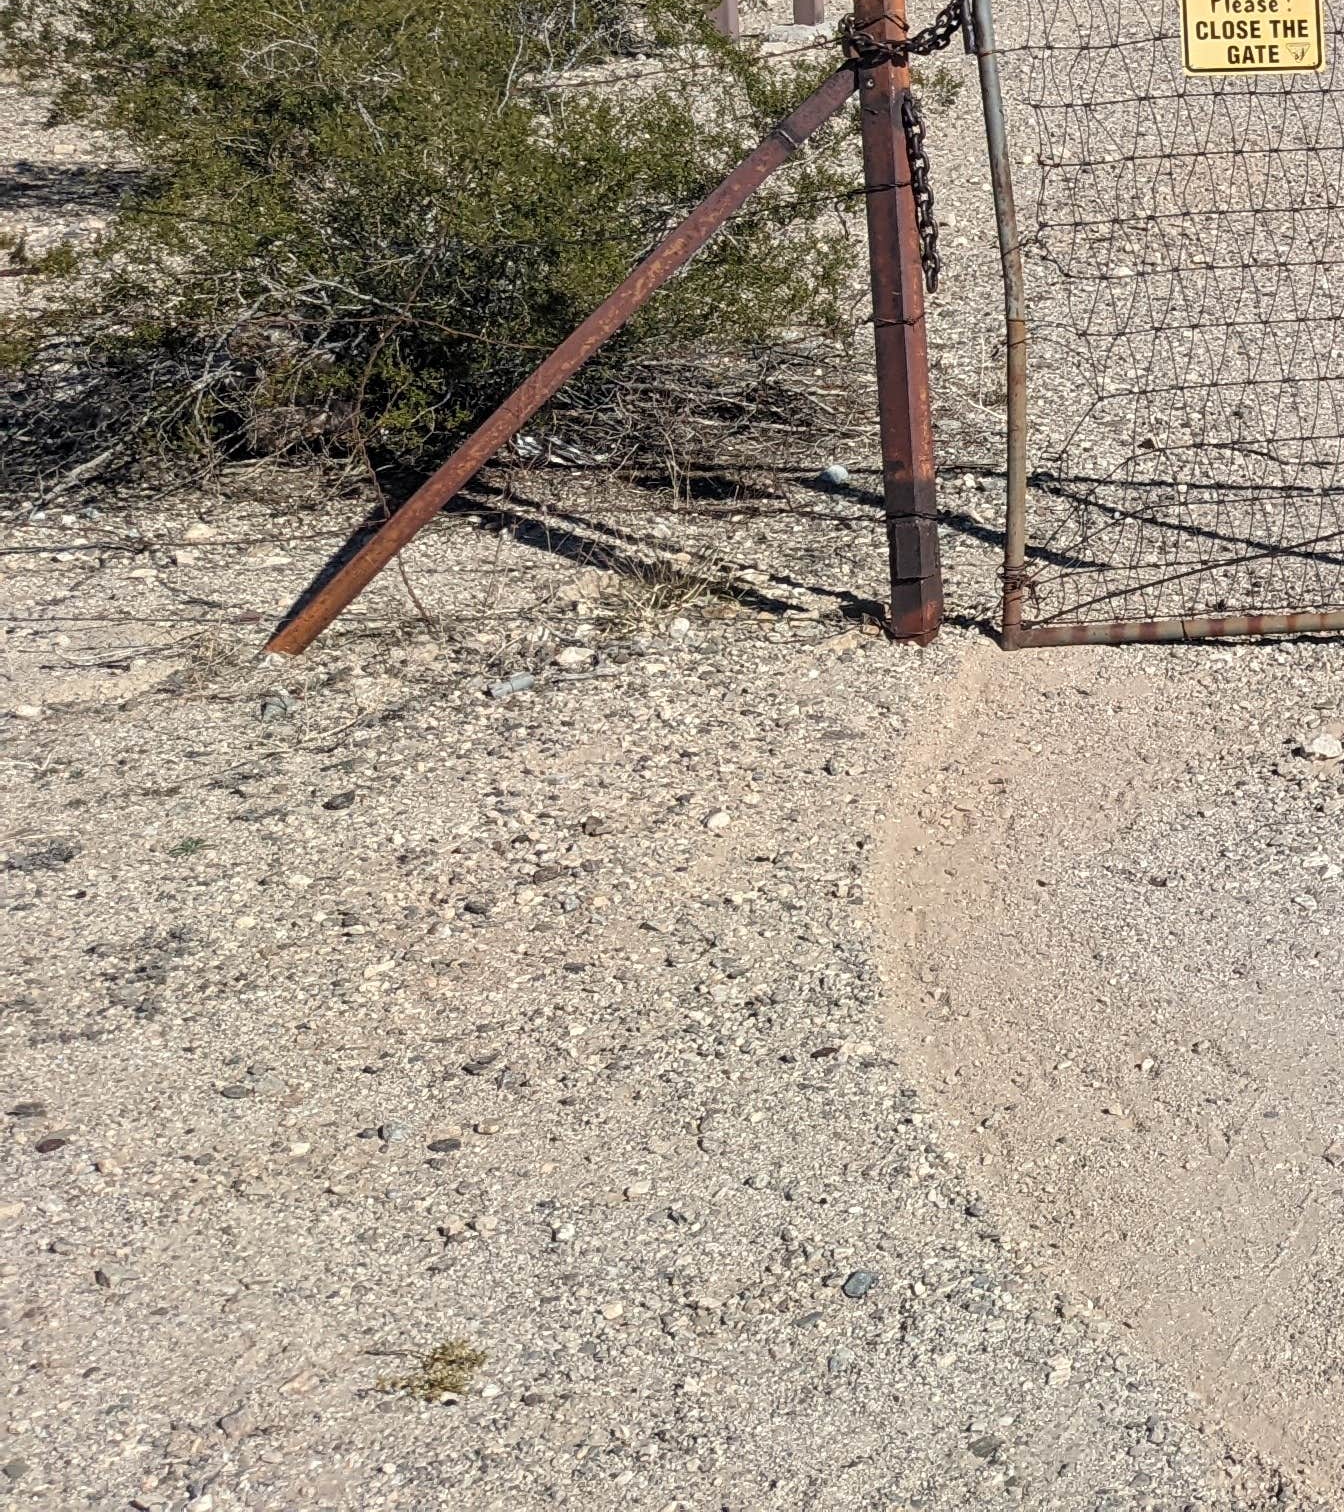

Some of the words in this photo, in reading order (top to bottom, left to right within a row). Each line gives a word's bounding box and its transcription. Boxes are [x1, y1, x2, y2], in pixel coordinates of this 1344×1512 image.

[1195, 20, 1262, 40] CLOSE
[1269, 19, 1309, 39] THE
[1227, 45, 1280, 64] GATE
